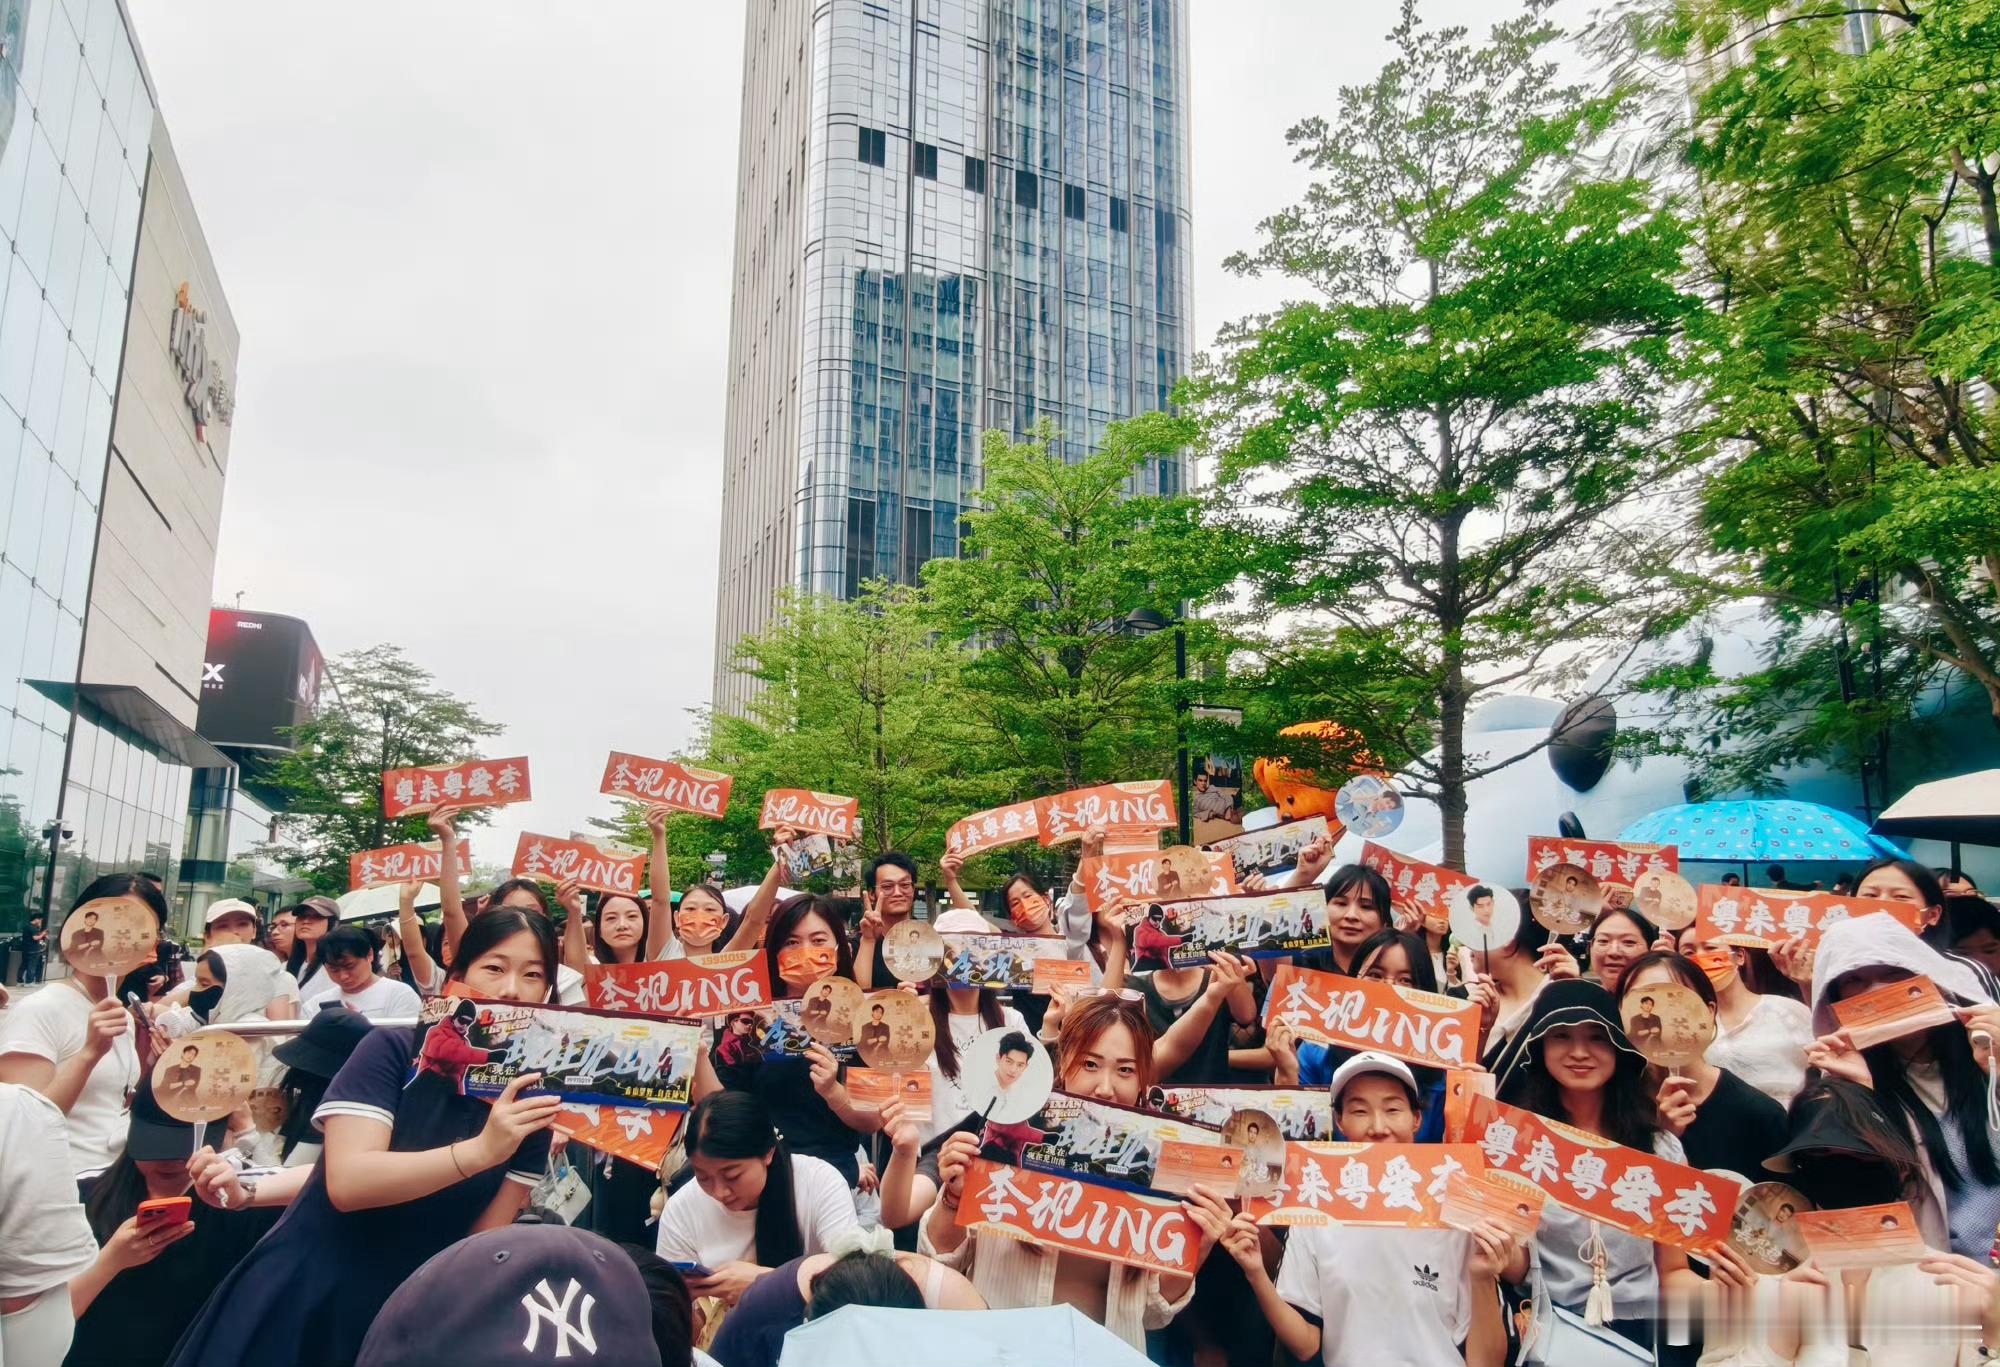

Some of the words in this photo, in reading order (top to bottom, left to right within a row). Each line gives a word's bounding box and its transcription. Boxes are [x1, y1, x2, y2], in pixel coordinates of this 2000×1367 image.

[702, 952, 748, 966] 19911019
[1412, 1280, 1438, 1292] adidas
[521, 1277, 597, 1357] NY
